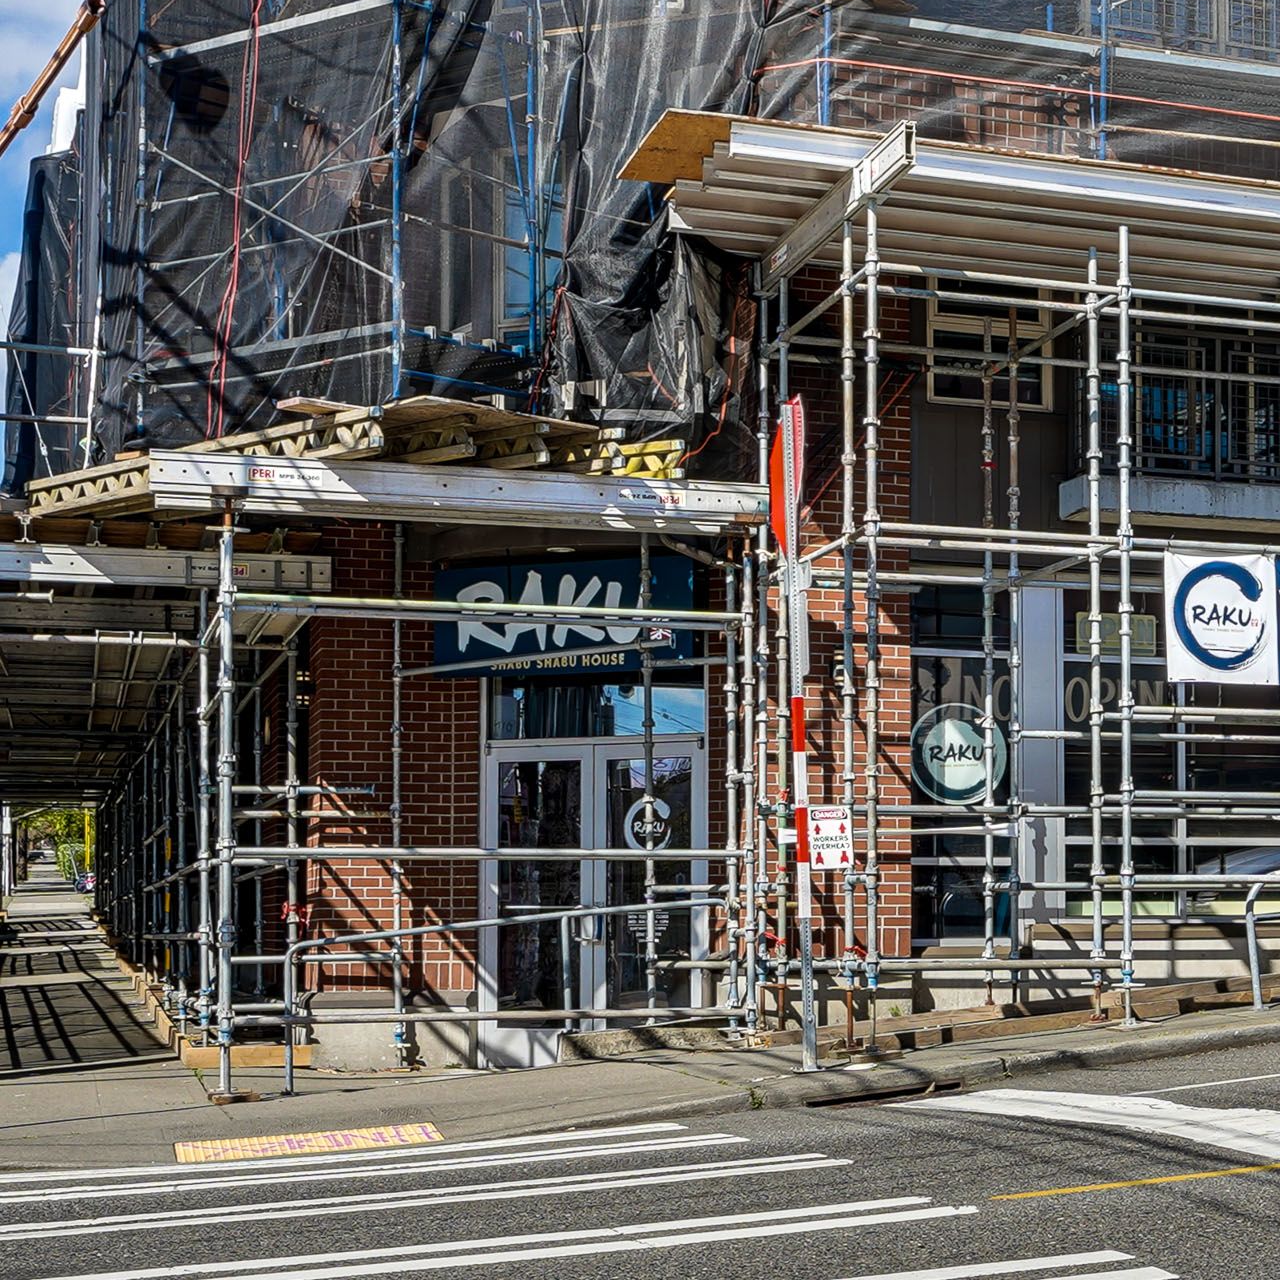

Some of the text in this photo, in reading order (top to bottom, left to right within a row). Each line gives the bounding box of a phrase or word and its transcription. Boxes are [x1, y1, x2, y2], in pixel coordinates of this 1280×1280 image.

[252, 468, 275, 479] PERI
[659, 495, 680, 505] PERI
[233, 567, 245, 576] PE
[456, 570, 643, 653] RAKU
[1192, 603, 1252, 626] RAKU
[1080, 617, 1154, 644] OPN
[536, 655, 577, 668] SHABU
[582, 653, 625, 667] HOUSE
[929, 742, 985, 763] RAKU
